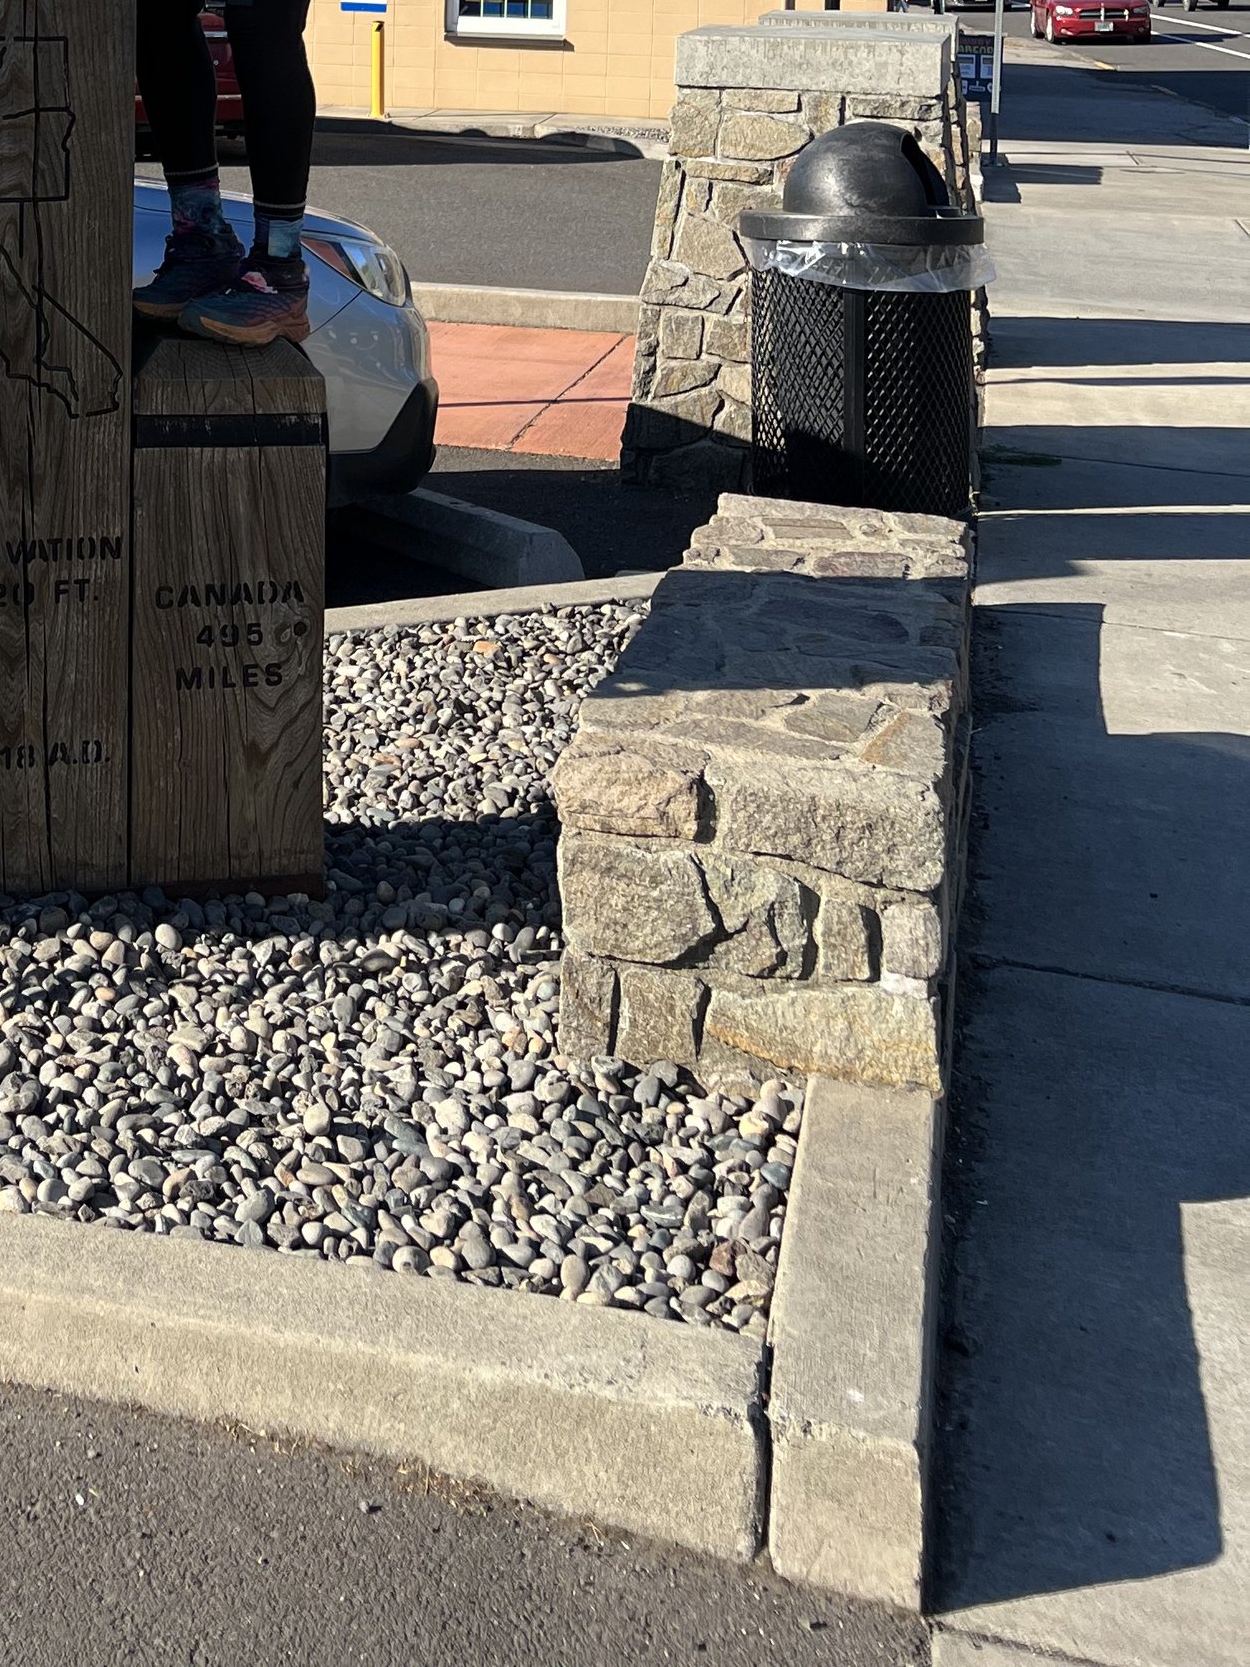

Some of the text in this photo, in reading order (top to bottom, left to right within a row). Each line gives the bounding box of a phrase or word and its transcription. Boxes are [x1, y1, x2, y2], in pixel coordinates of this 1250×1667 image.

[54, 578, 100, 605] FT.
[155, 580, 305, 610] CANADA
[196, 622, 264, 648] 495
[176, 662, 284, 691] MILES
[49, 739, 111, 768] A.D.
